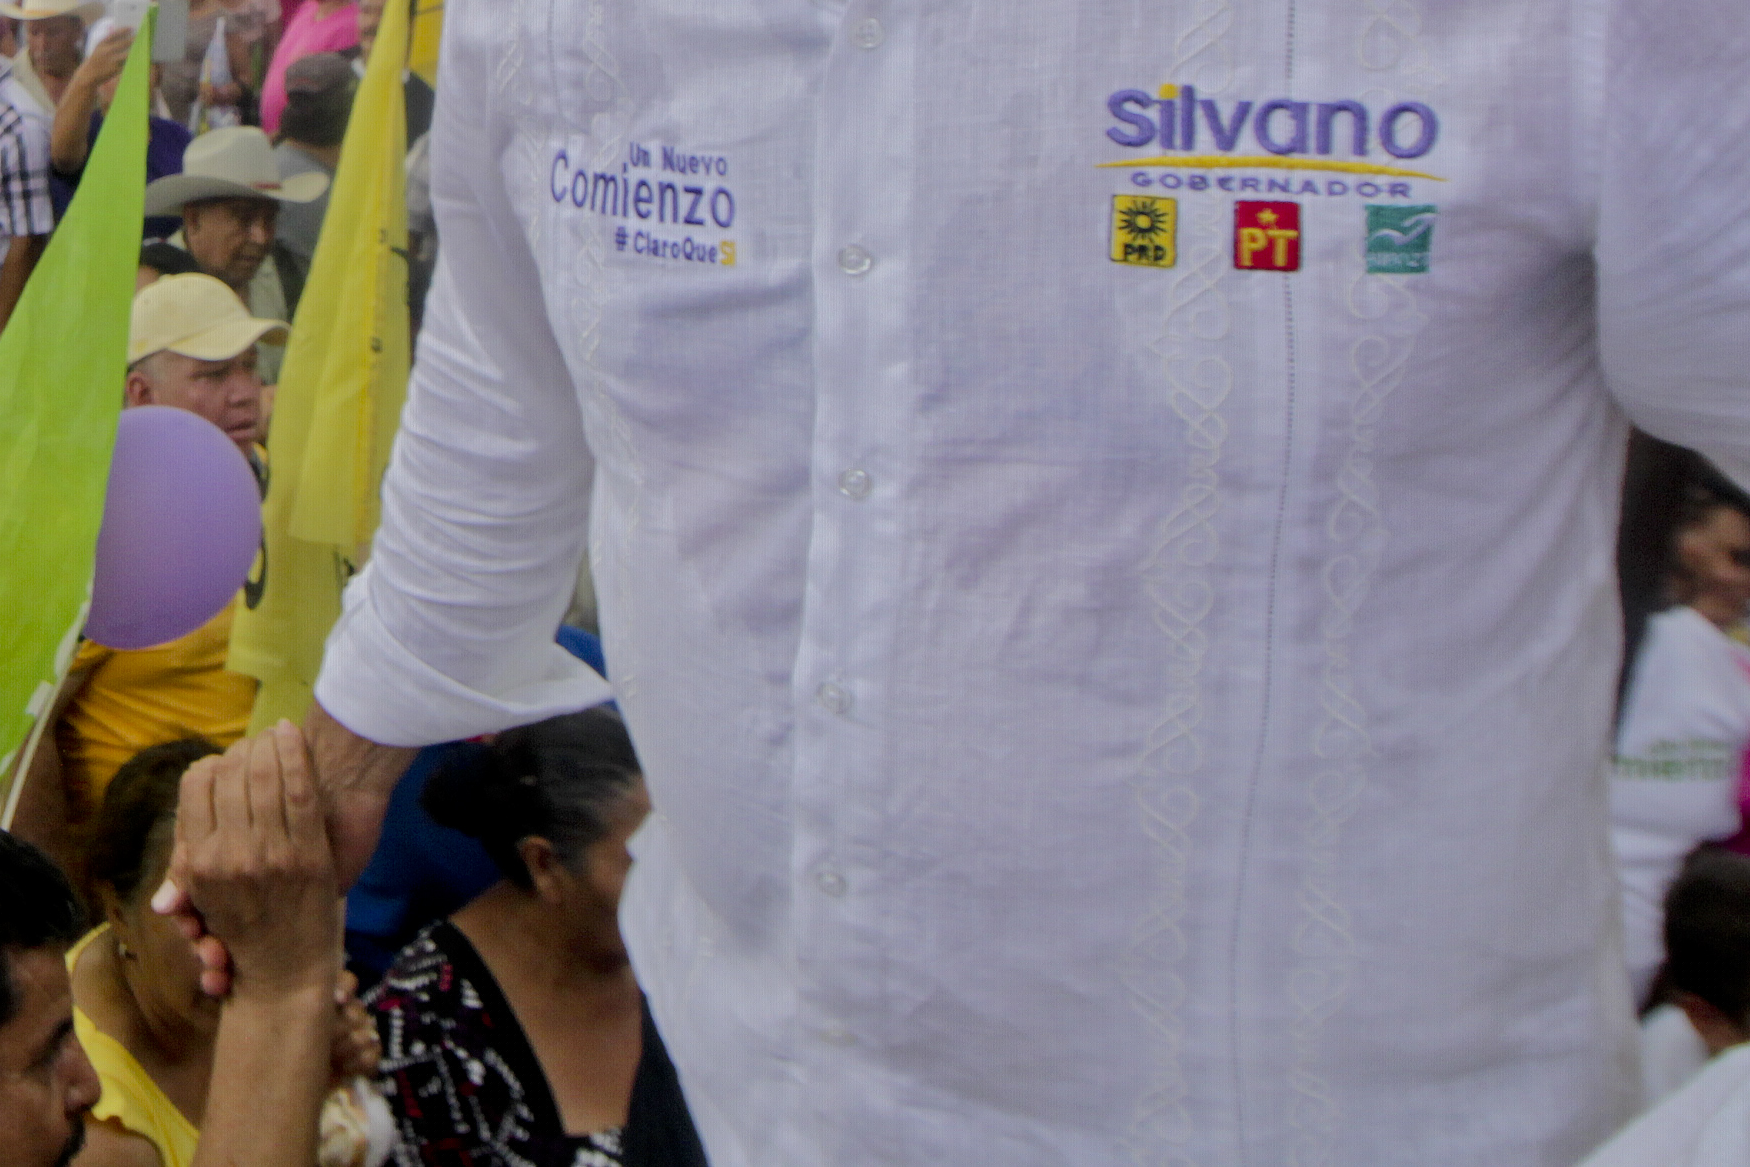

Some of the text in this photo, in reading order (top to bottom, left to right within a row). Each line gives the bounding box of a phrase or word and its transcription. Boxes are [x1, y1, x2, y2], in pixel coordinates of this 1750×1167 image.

[629, 141, 728, 176] Un Nuevo
[551, 148, 735, 229] Comienzo
[1131, 171, 1412, 198] GOBERNADOR
[1123, 242, 1167, 263] PRD
[1239, 228, 1299, 267] PT
